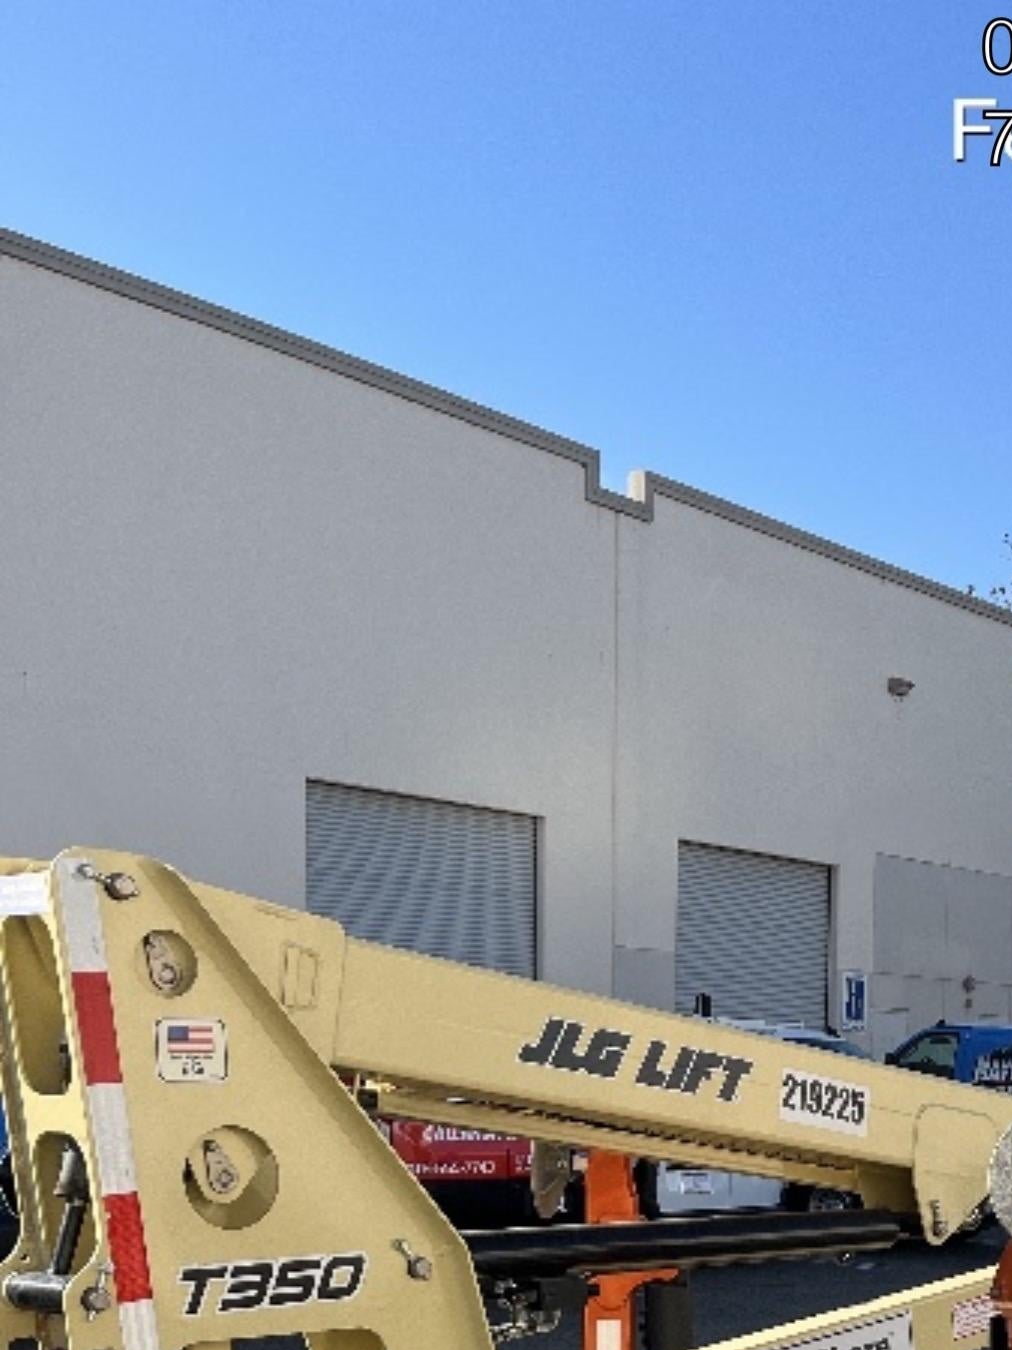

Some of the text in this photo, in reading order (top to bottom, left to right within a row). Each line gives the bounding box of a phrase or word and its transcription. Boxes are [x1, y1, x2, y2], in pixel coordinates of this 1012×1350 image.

[518, 1016, 754, 1102] JLG LIFT
[782, 1073, 865, 1125] 219225
[179, 1253, 366, 1314] T350
